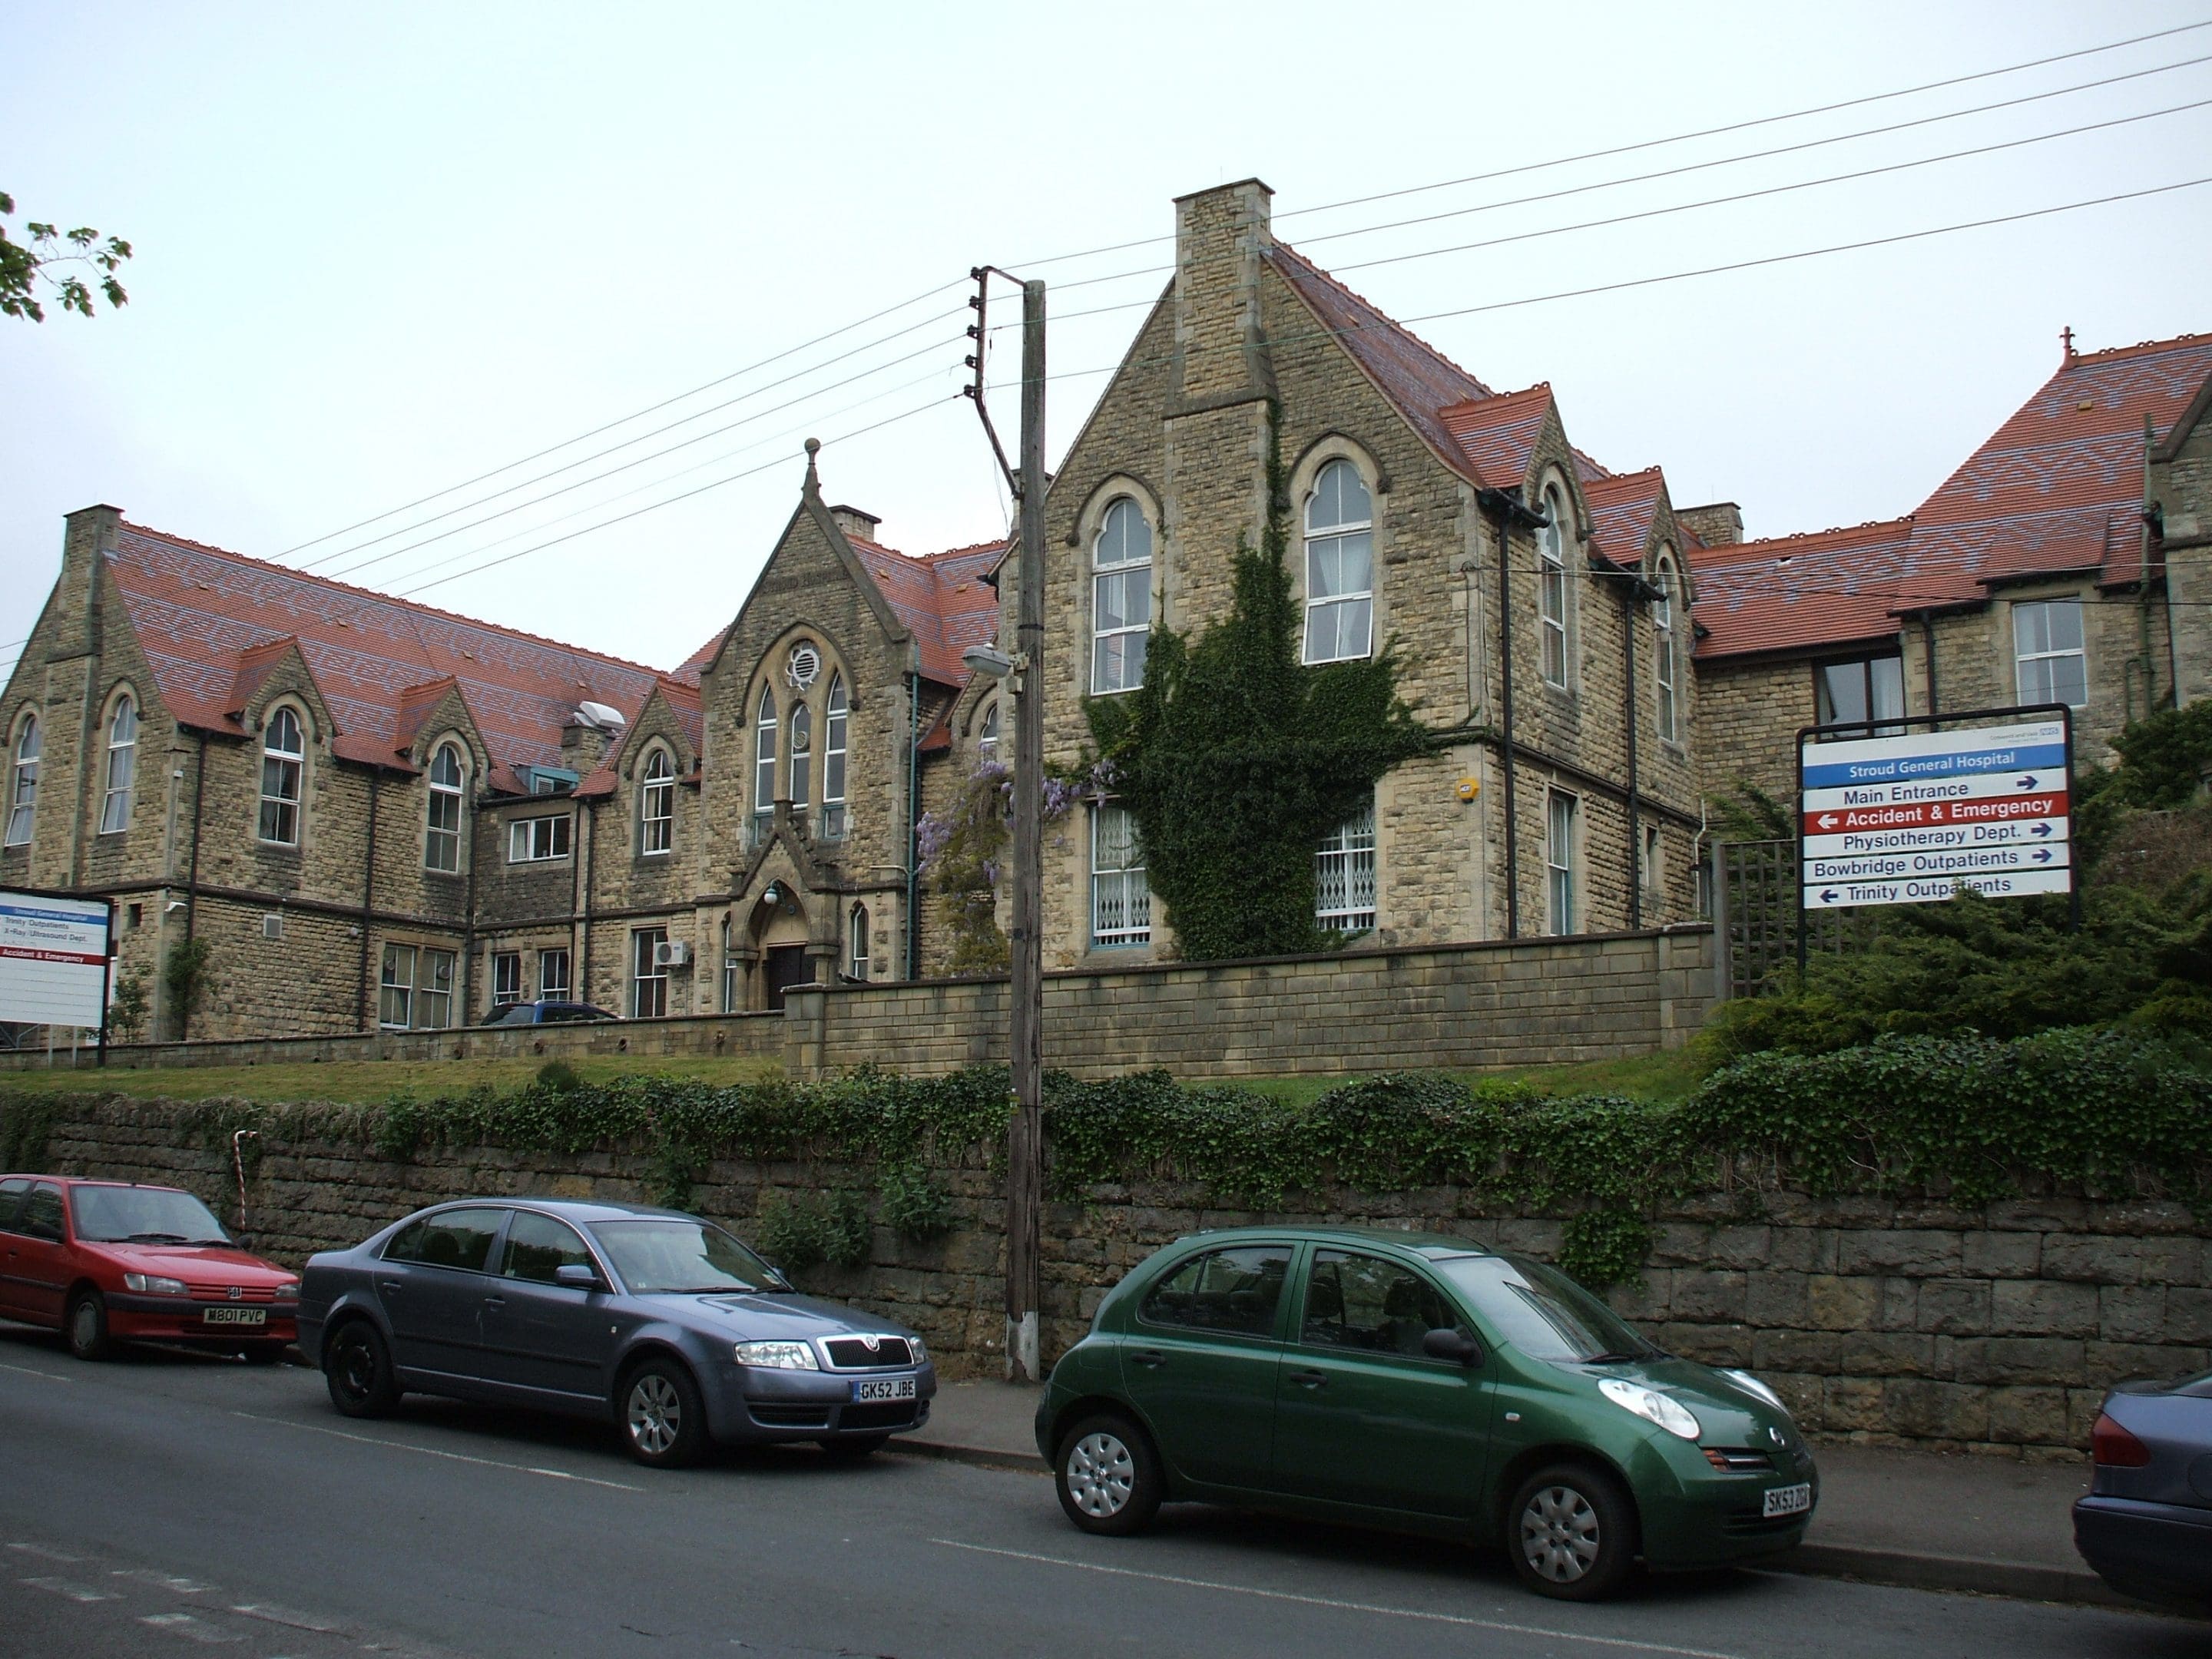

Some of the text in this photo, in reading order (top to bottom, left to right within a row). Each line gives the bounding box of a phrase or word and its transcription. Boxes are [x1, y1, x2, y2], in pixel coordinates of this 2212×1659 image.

[1849, 752, 2015, 778] Stroud General Hospital
[1844, 783, 1969, 805] Main Entrance
[1846, 799, 2053, 826] Accident & Emergency
[1844, 824, 2022, 851] Physiotherapy Dept.
[1814, 850, 2018, 877] Bowbridge Outpatients
[1847, 883, 1898, 901] Trinity
[5, 917, 69, 929] Trinity Outpatients
[5, 927, 26, 937] X-Ray
[2, 949, 35, 958] Accident
[45, 952, 85, 963] Emergency
[862, 1381, 914, 1399] GK52 JBE
[1769, 1490, 1793, 1512] SK53
